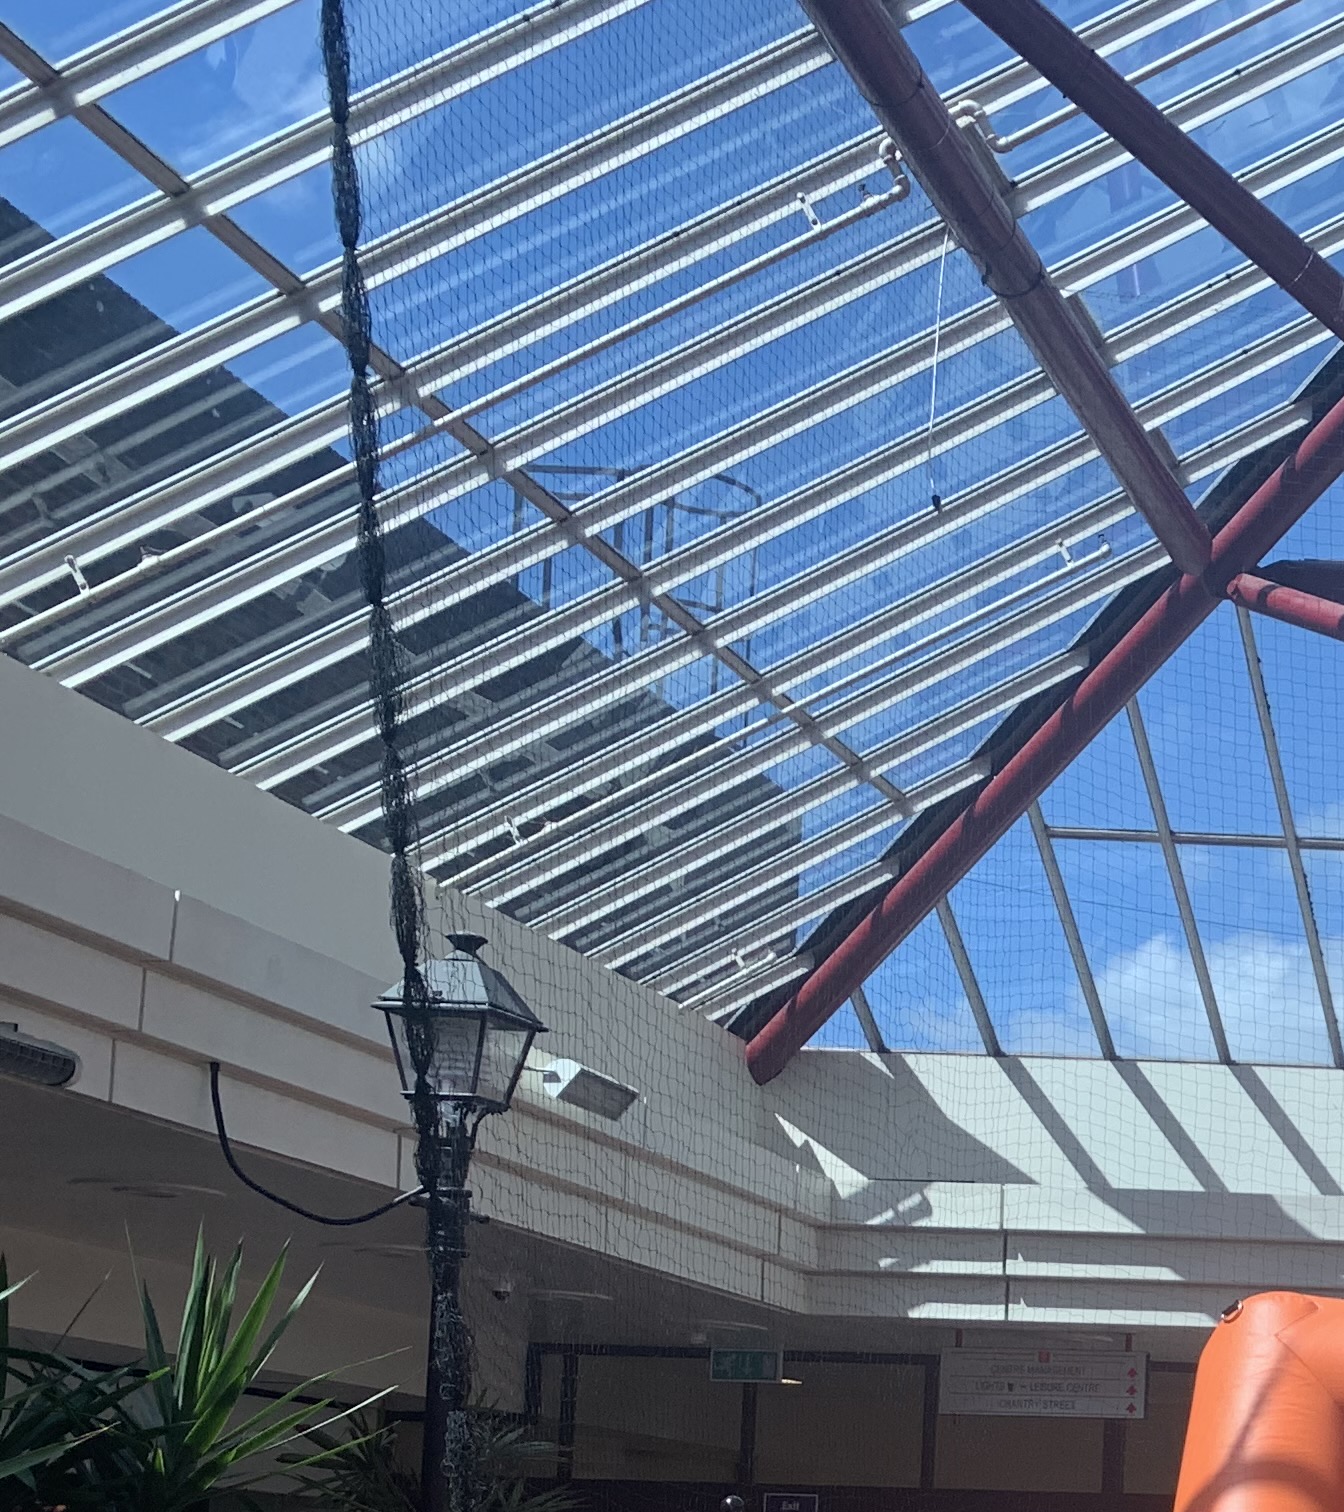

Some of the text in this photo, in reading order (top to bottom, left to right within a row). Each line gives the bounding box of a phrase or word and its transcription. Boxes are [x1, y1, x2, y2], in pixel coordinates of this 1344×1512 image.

[1027, 1365, 1086, 1377] MANAGEMENT
[1029, 1382, 1065, 1392] LEISURE
[1043, 1400, 1076, 1410] STREET
[781, 1500, 800, 1511] Exit
